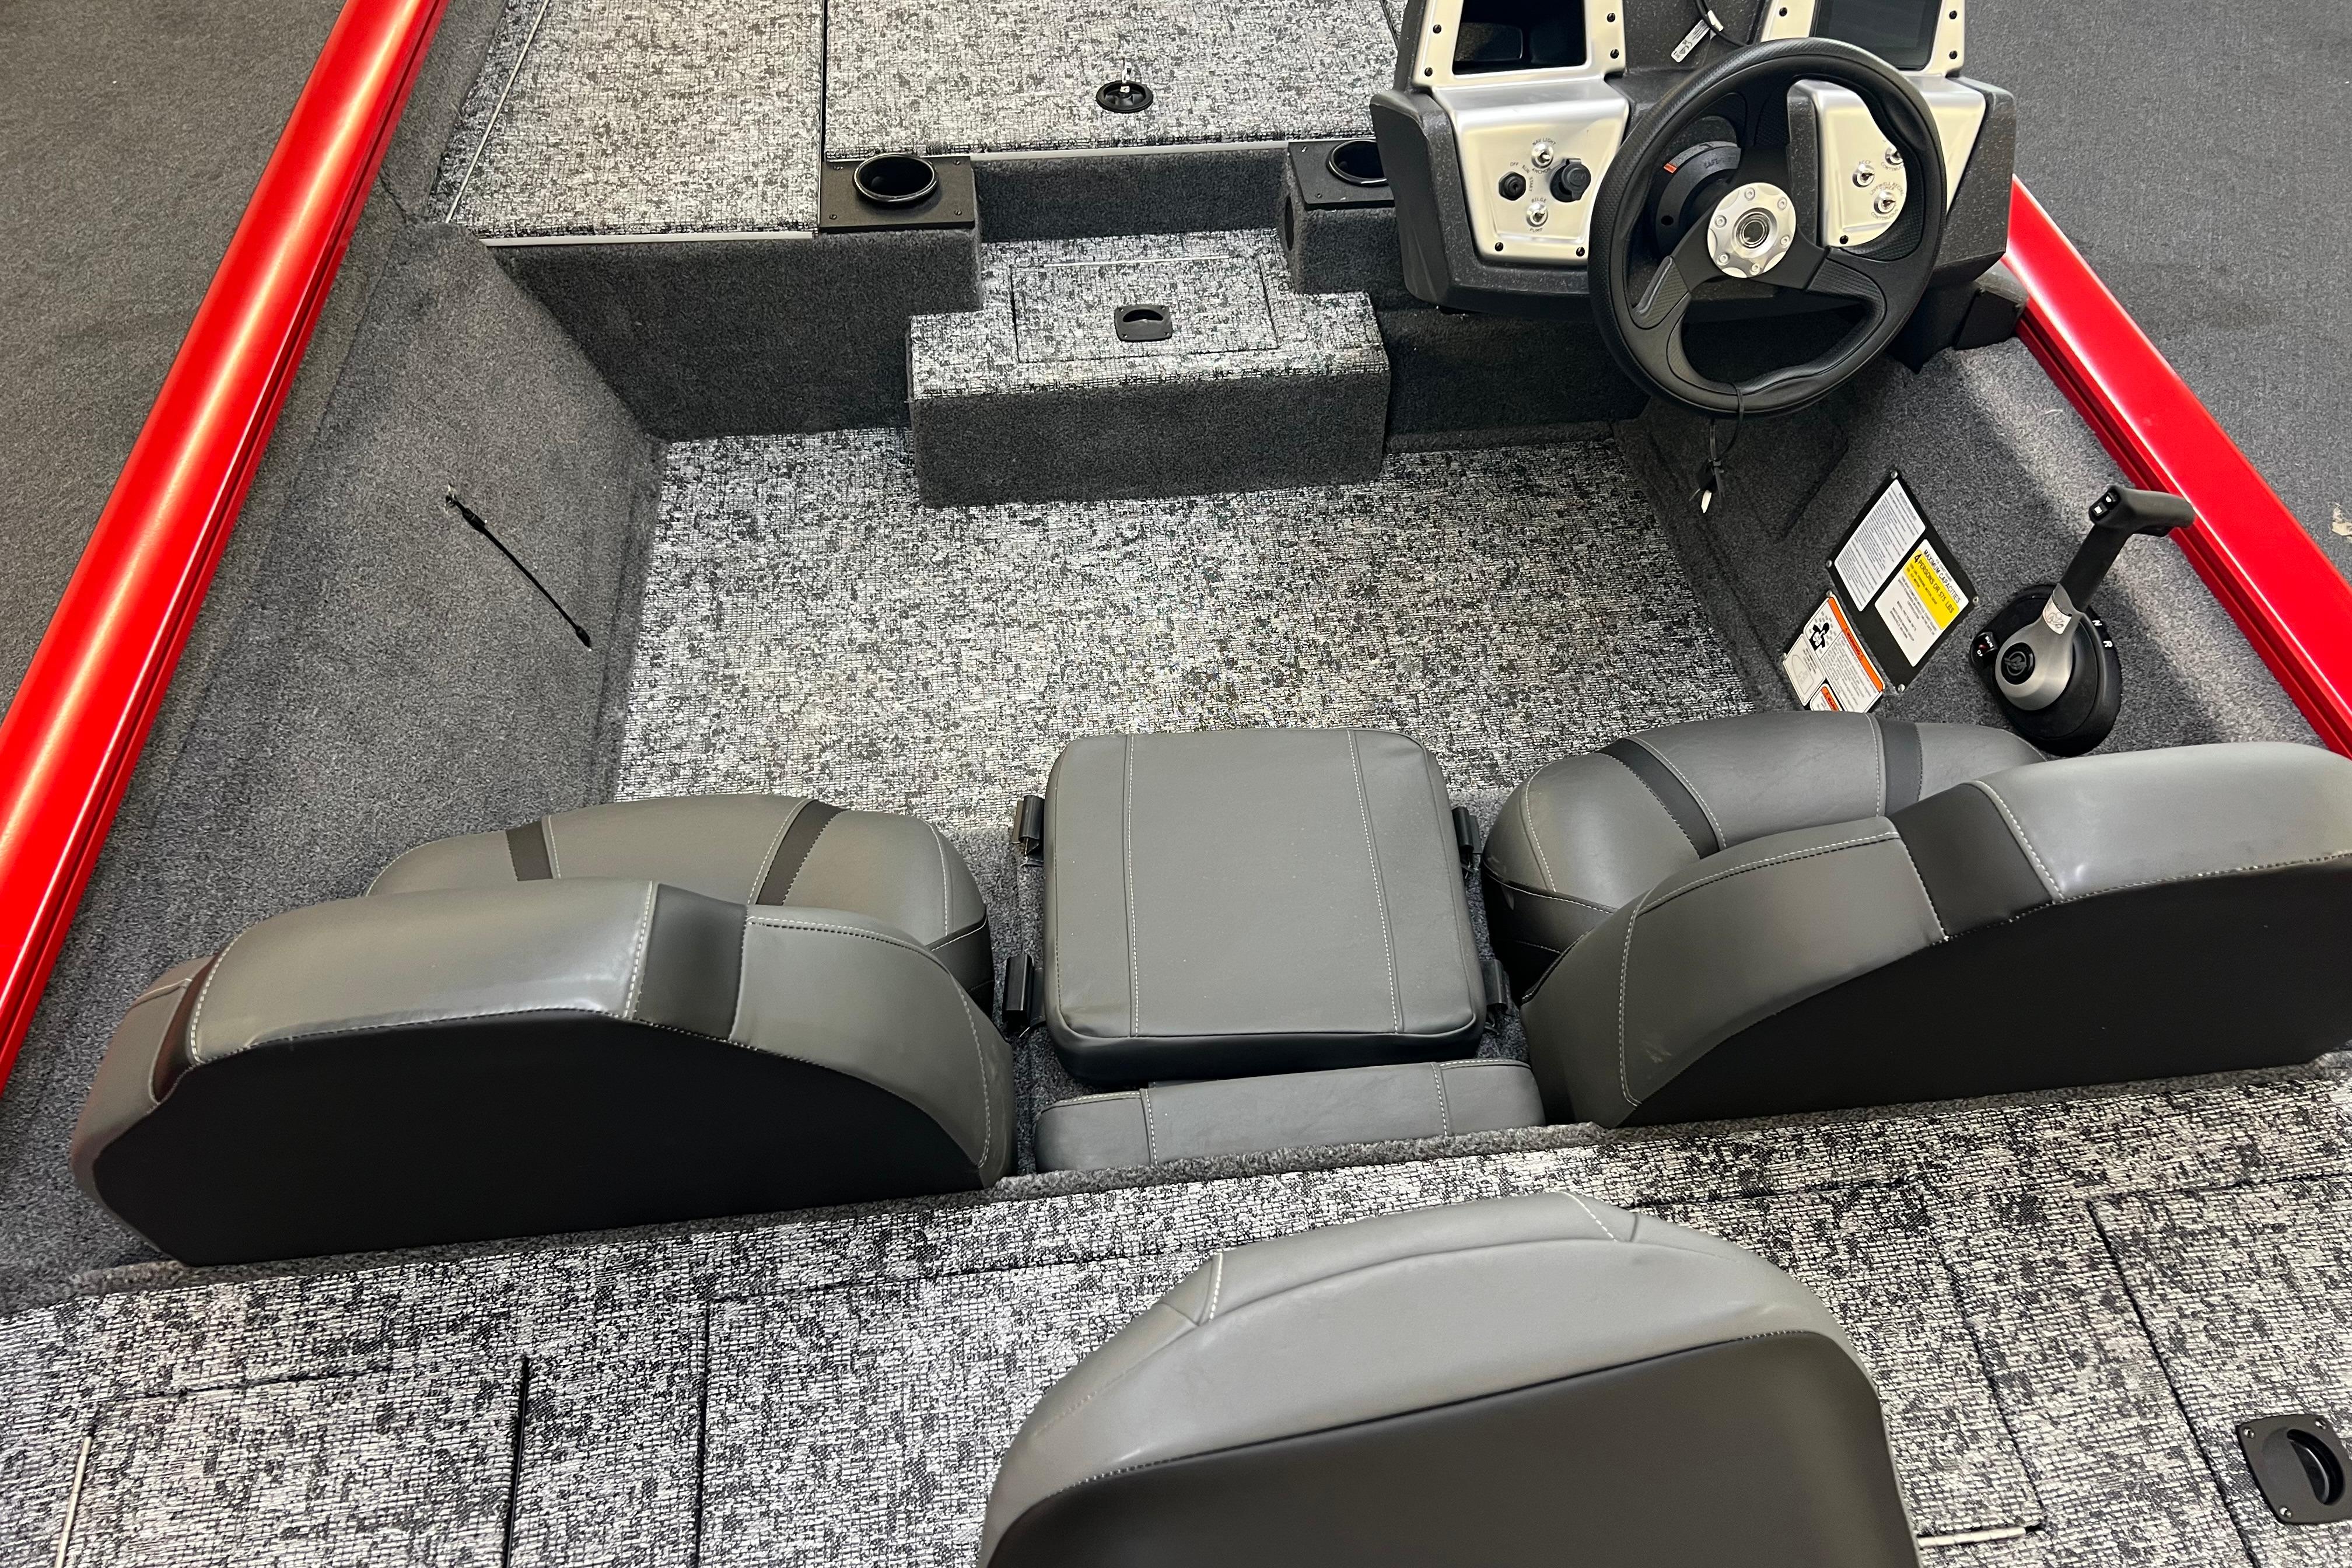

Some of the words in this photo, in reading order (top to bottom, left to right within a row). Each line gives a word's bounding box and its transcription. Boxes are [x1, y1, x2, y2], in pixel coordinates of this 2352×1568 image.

[1542, 137, 1556, 145] LIGHT
[1914, 554, 1922, 563] 4
[1918, 559, 1935, 584] PERSONS
[1933, 583, 1940, 593] OR
[1938, 592, 1947, 602] 575
[1945, 601, 1955, 614] LBS
[1923, 549, 1941, 573] MAXIMUM
[1938, 572, 1961, 604] CAPACITIES
[1985, 636, 1994, 648] RUN
